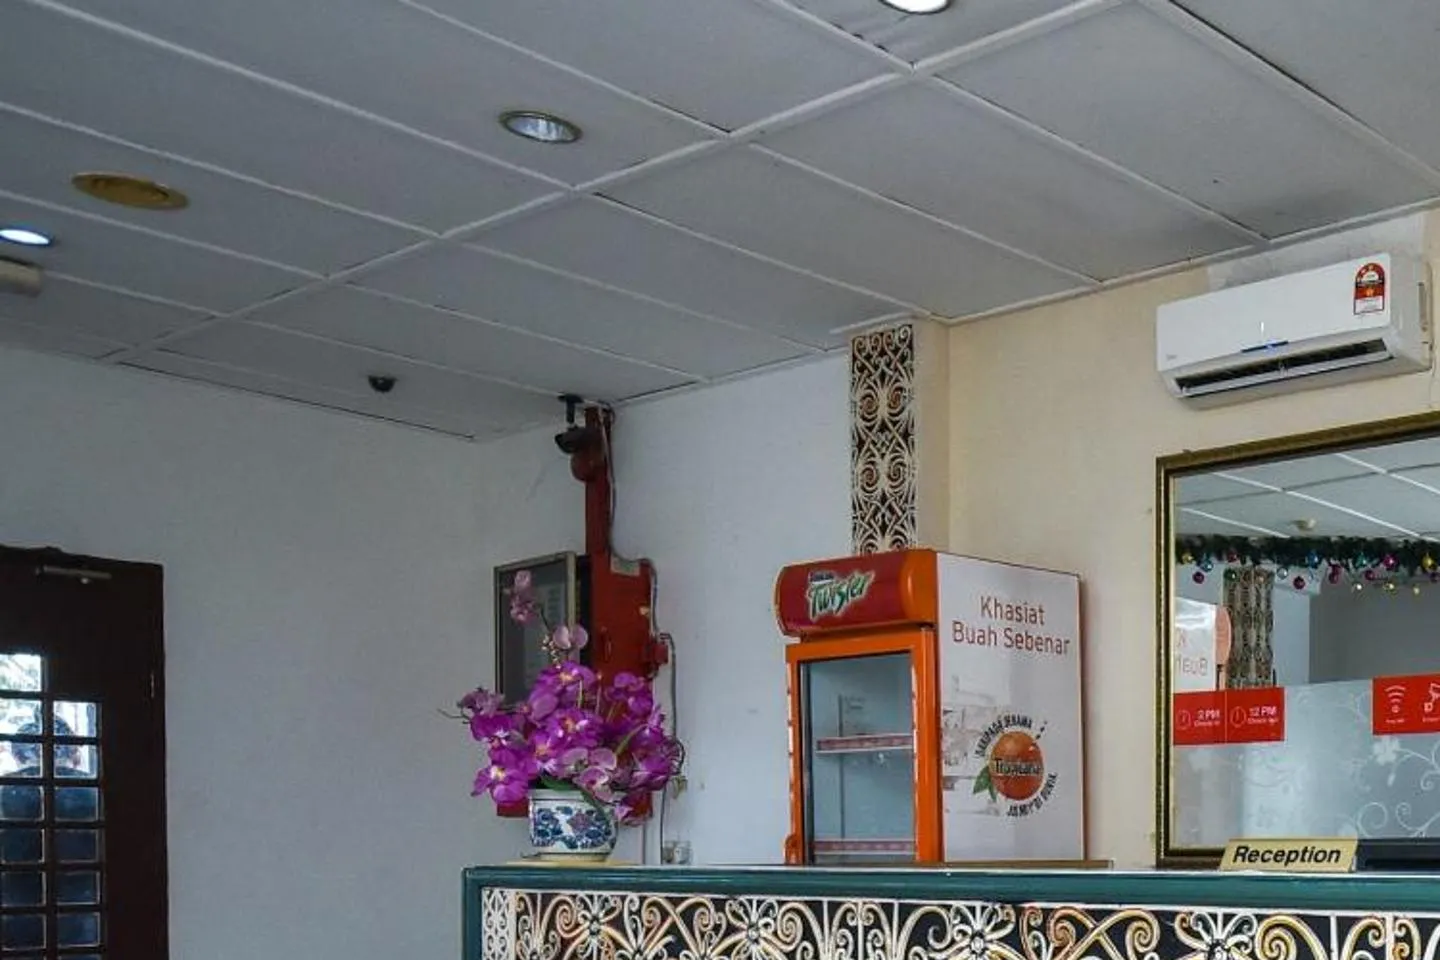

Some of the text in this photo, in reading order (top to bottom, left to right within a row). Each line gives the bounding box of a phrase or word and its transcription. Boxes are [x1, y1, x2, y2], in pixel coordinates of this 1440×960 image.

[809, 574, 871, 618] Twister
[980, 596, 1046, 626] Khasiat
[952, 620, 1070, 655] Buah Sebenar
[1232, 846, 1341, 867] Reception
